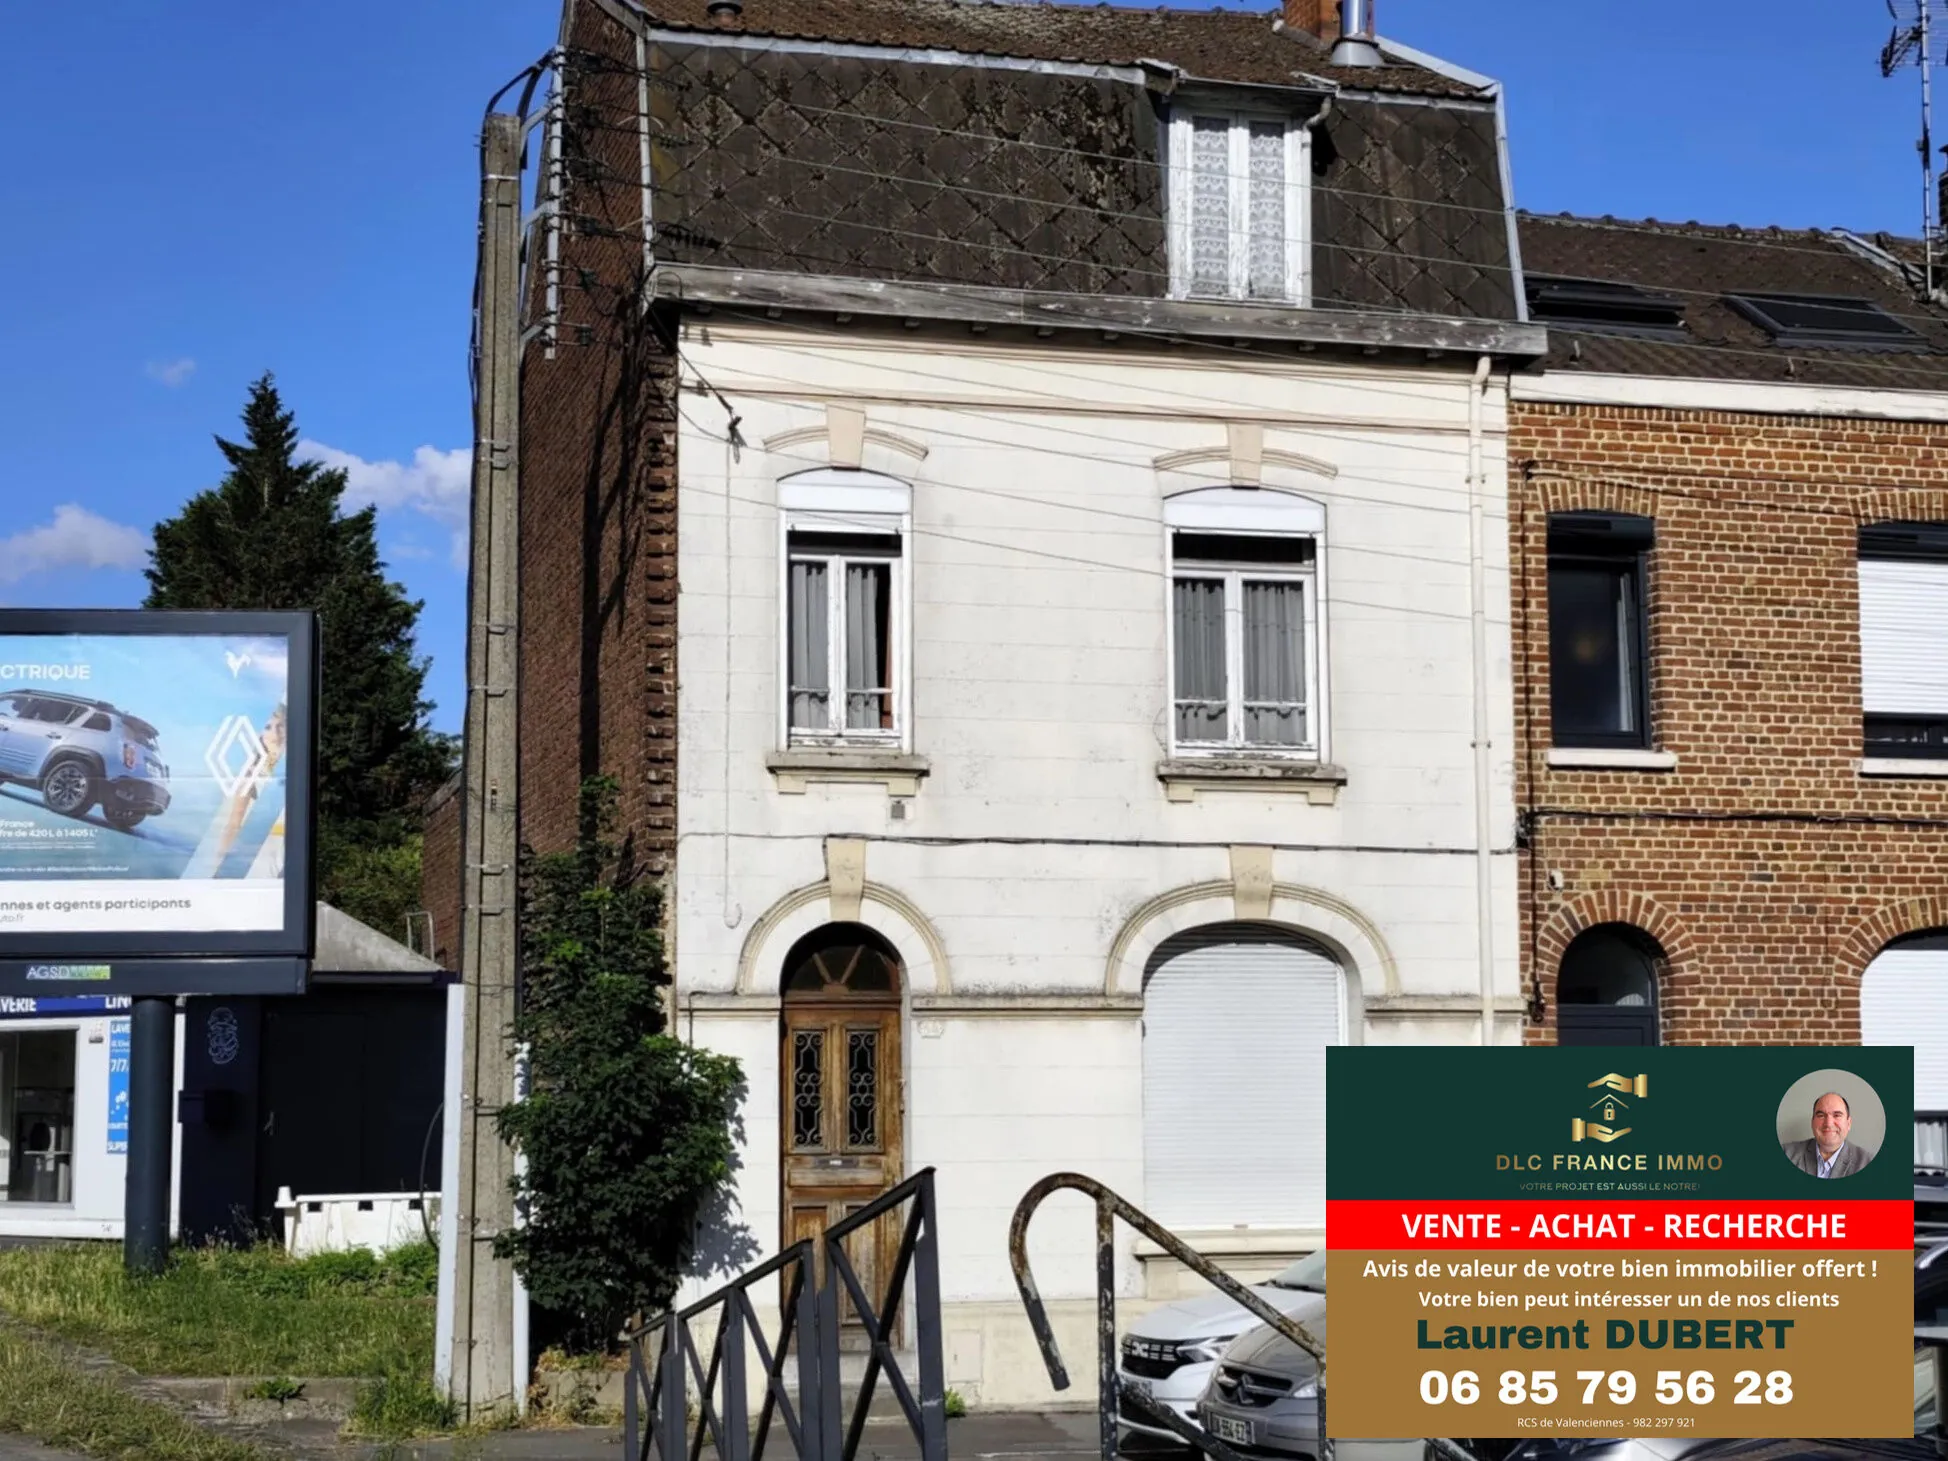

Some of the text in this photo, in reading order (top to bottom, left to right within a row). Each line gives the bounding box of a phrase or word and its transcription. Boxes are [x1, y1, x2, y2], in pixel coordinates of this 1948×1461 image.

[0, 664, 91, 681] CTRIQUE
[36, 901, 50, 911] et
[53, 900, 101, 912] agents
[104, 898, 191, 911] participants
